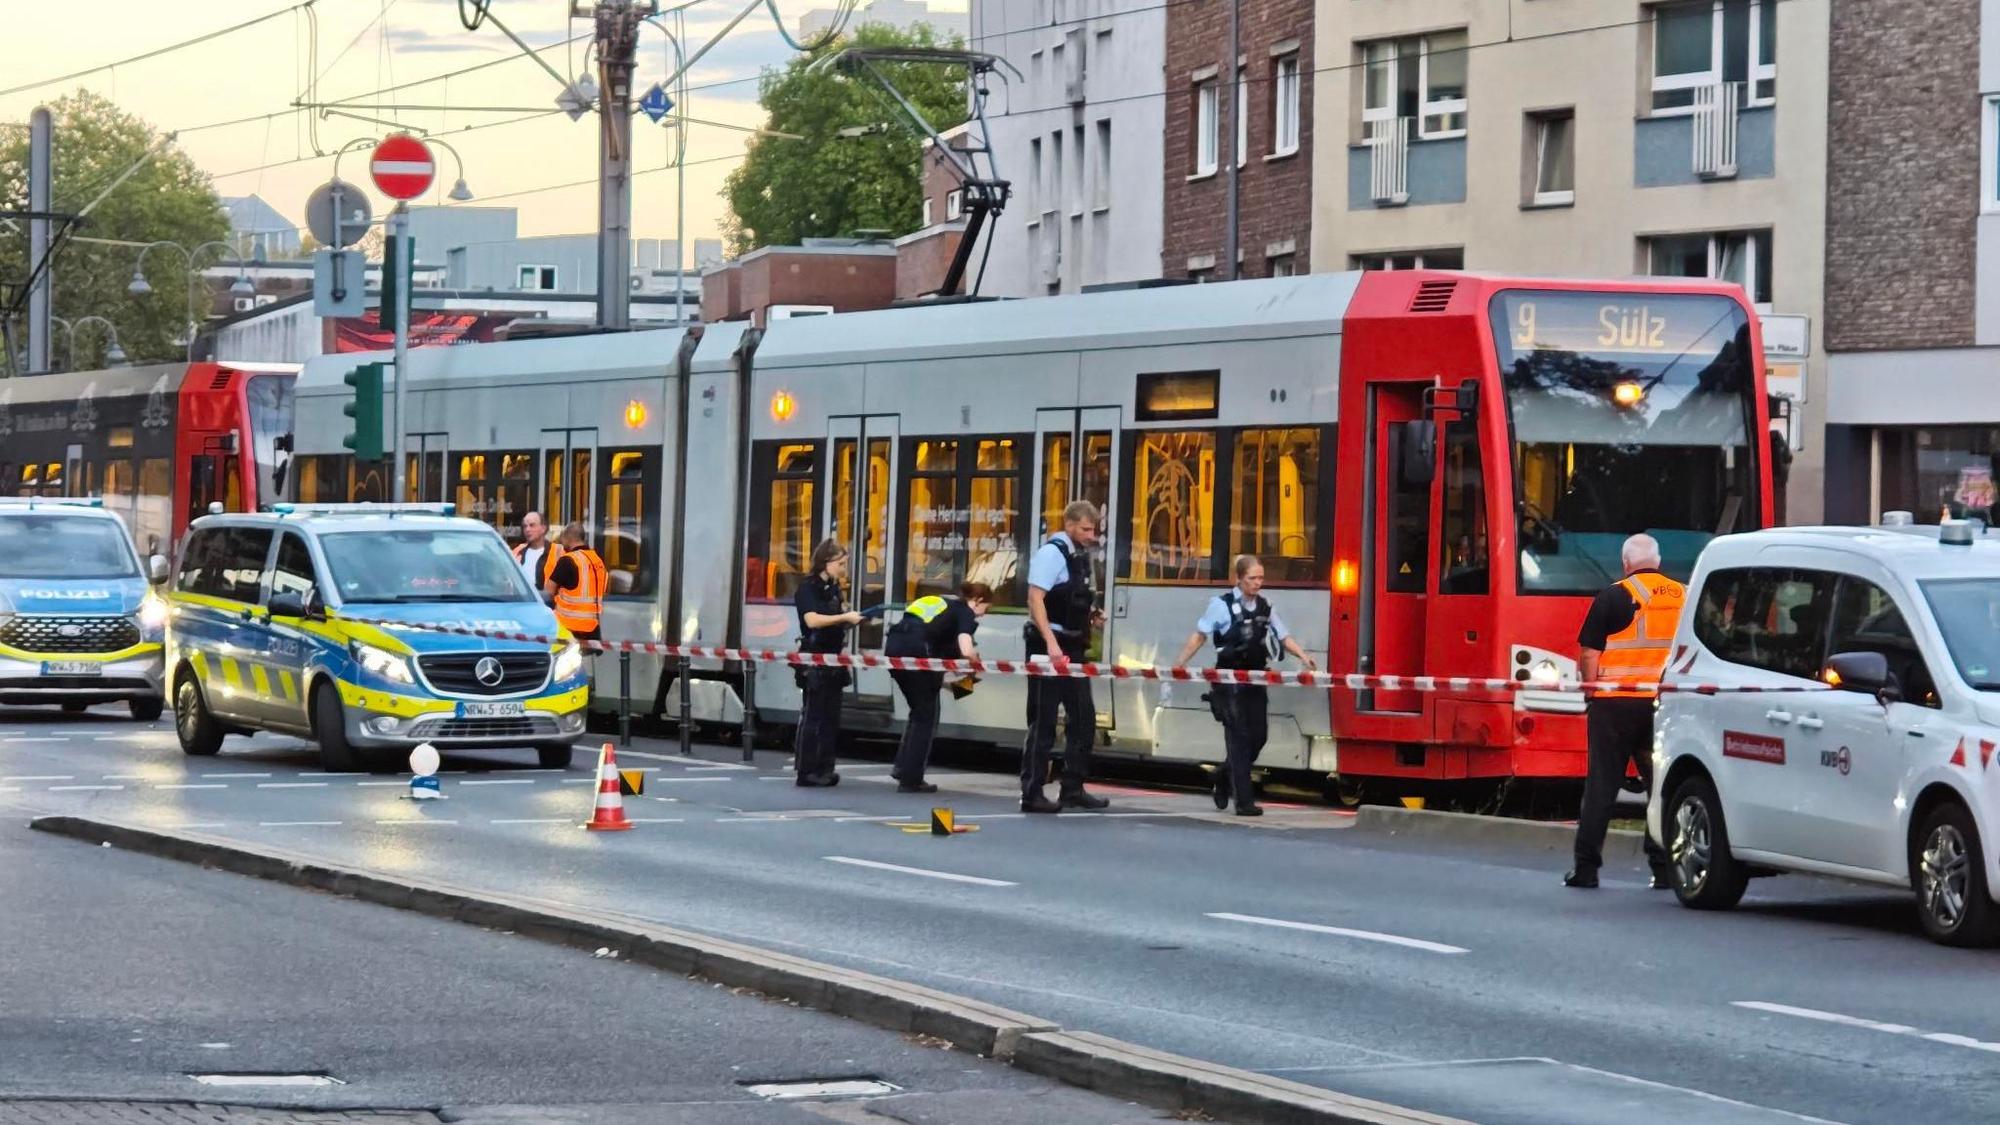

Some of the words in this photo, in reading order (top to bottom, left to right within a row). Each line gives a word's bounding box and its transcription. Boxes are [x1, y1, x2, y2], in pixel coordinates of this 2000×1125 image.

[1516, 302, 1536, 345] 9
[1598, 304, 1666, 347] Sülz
[20, 588, 110, 600] POLIZEI
